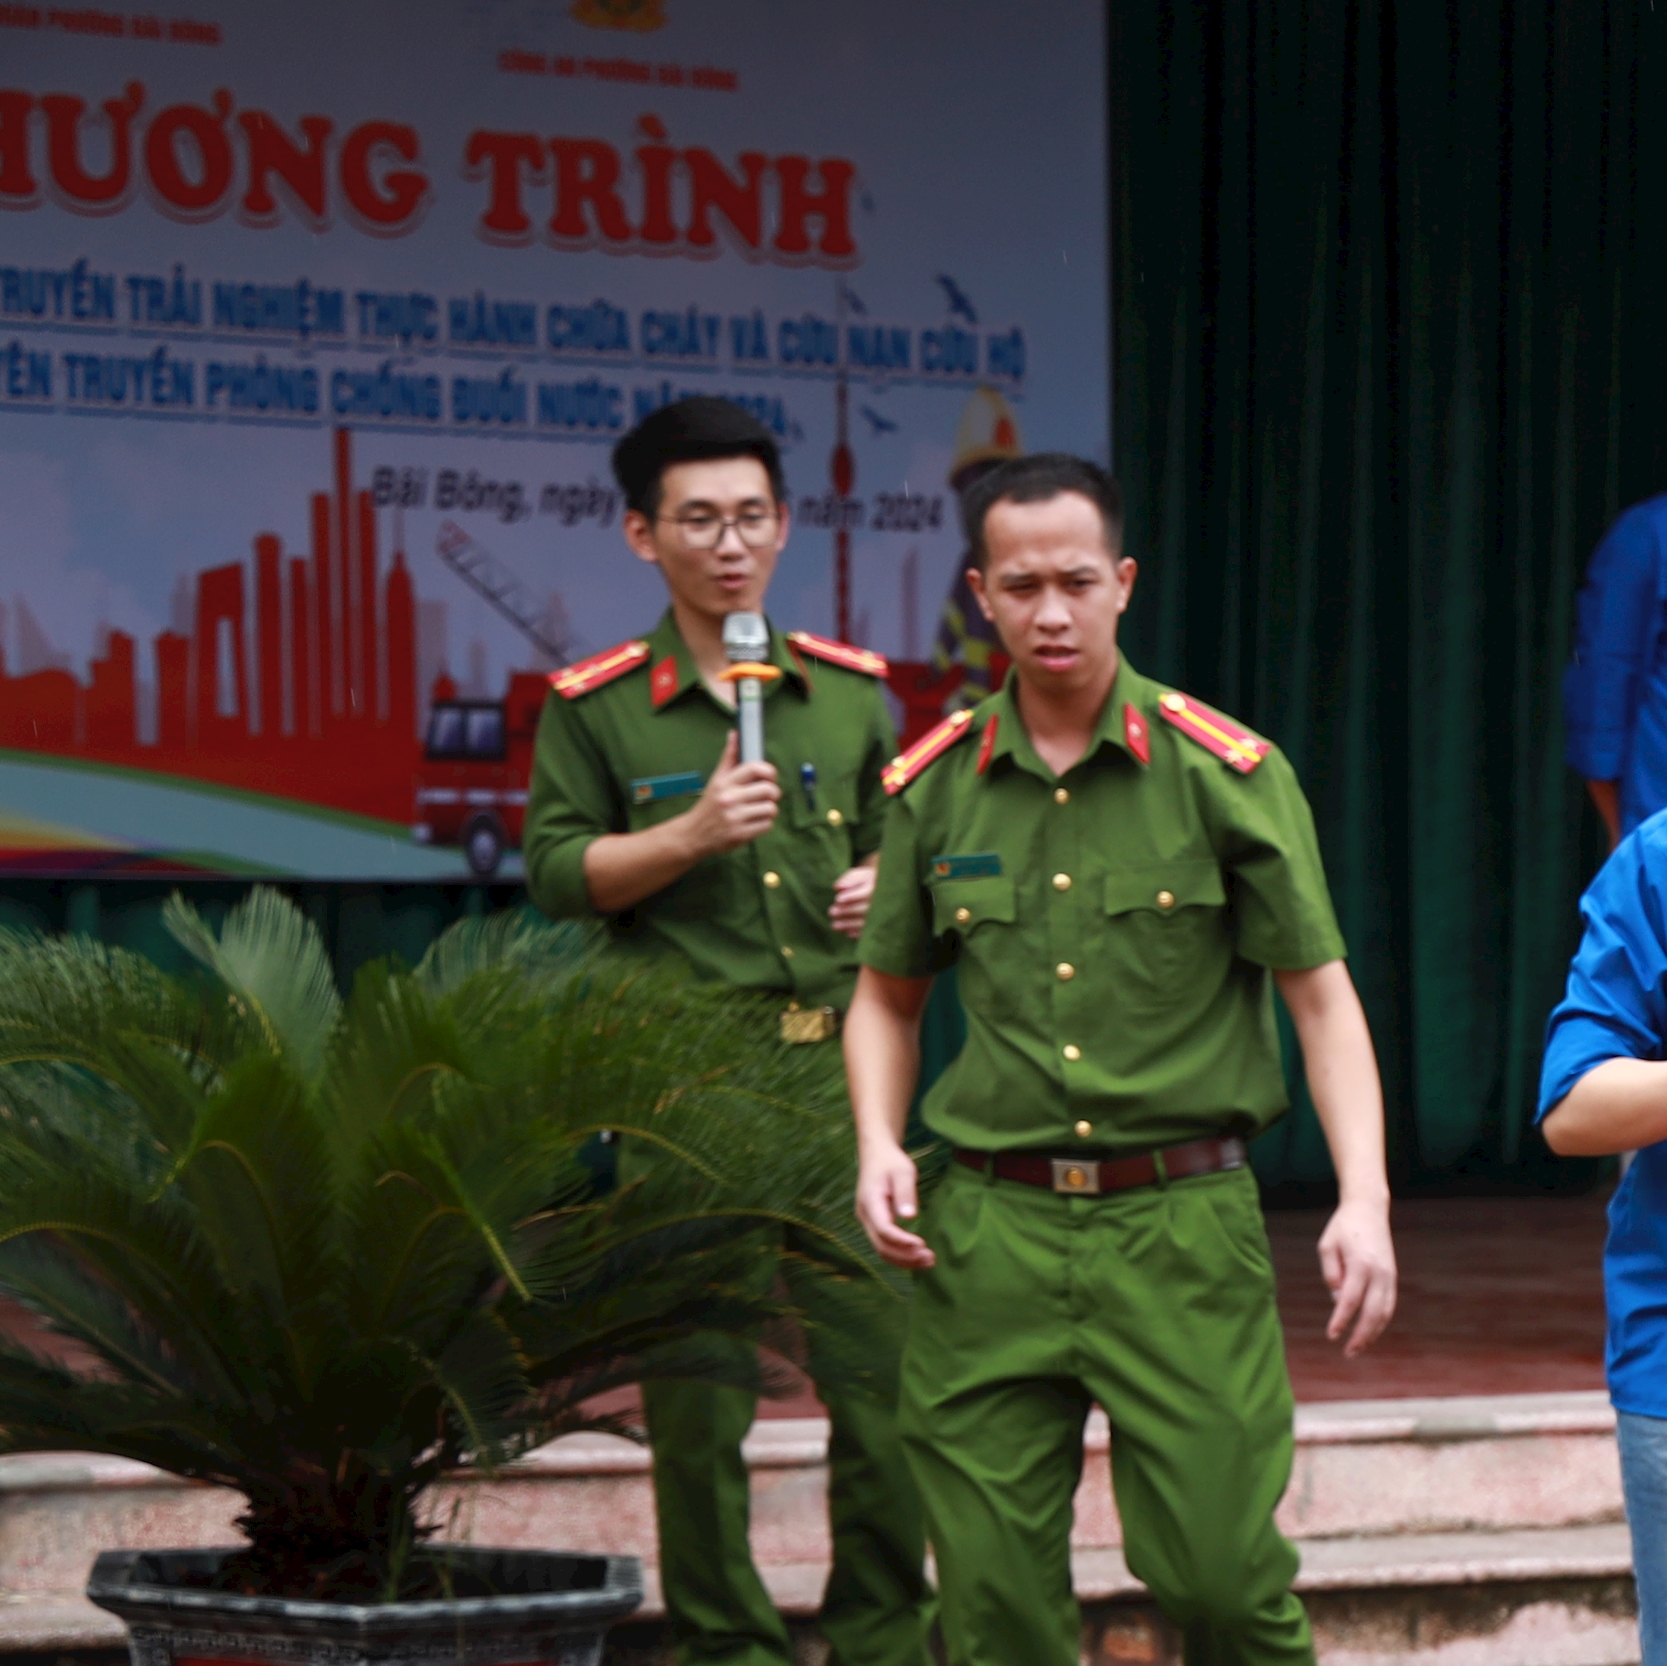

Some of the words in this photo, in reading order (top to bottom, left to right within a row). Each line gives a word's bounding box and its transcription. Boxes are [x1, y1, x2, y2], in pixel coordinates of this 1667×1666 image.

[464, 113, 856, 257] TRÌNH
[448, 289, 537, 346] HÀNH
[330, 360, 440, 420] CHỐNG
[872, 492, 945, 532] 2024
